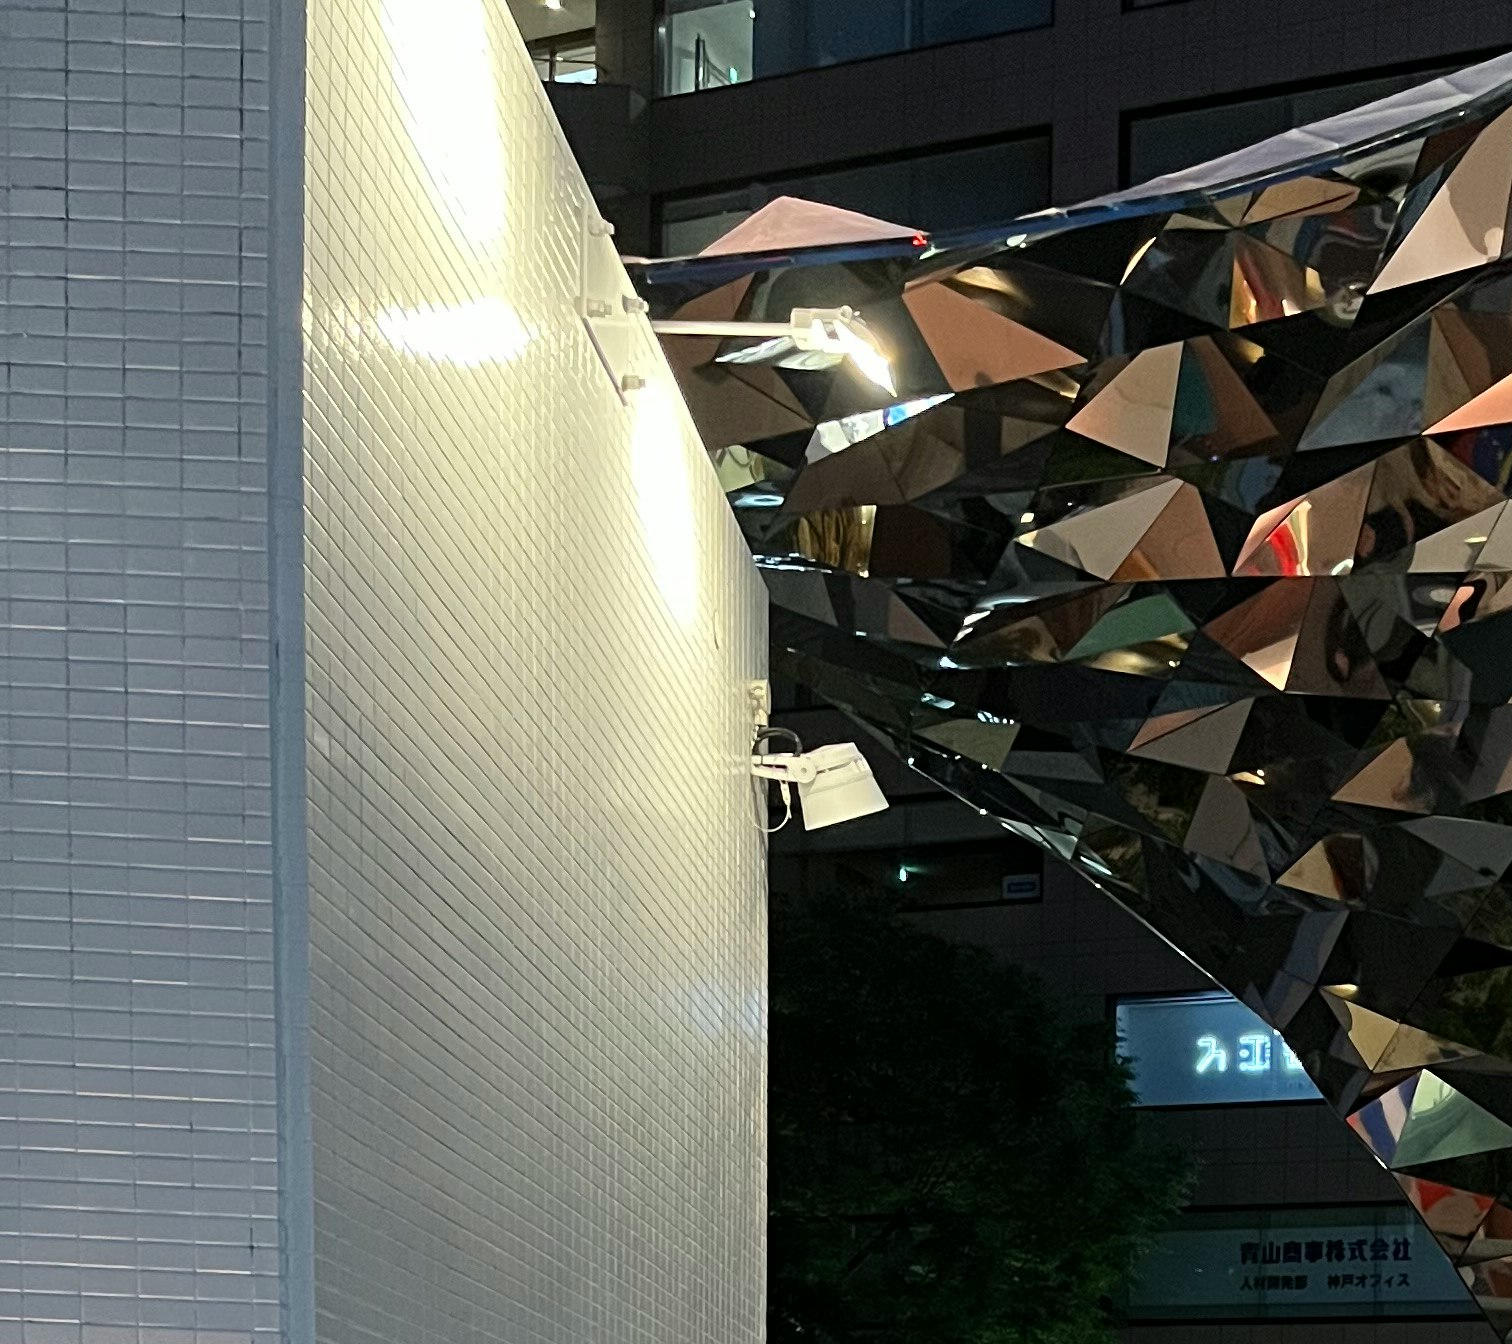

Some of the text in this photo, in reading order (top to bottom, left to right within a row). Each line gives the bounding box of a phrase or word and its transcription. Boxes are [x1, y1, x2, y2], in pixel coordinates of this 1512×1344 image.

[1240, 1237, 1412, 1265] 青山商事株式会社
[1327, 1273, 1410, 1289] 神戸オフィス
